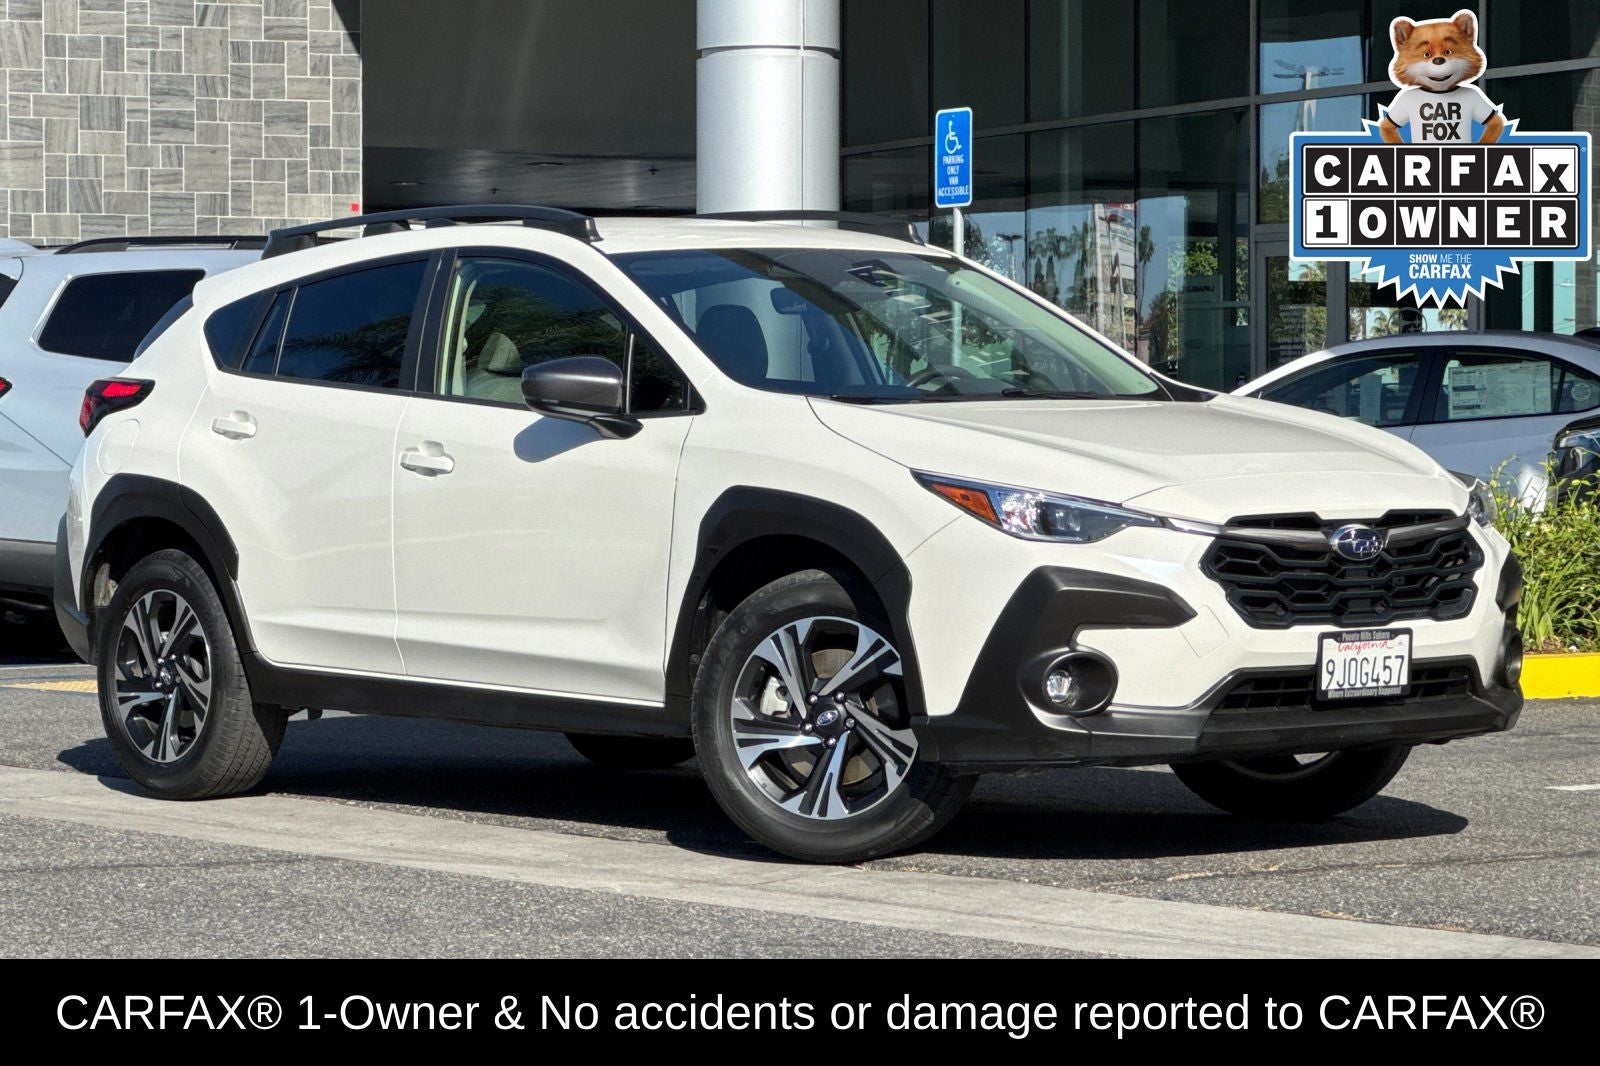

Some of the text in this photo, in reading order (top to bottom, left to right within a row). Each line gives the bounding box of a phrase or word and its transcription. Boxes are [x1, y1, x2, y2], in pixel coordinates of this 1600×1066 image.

[942, 154, 964, 165] PARKING
[946, 165, 959, 175] ONLY
[948, 176, 959, 185] VAN
[938, 185, 969, 196] ACCESSIBLE
[1373, 630, 1391, 640] Subaru
[1337, 640, 1395, 656] California
[1327, 690, 1344, 699] Where
[1344, 688, 1377, 698] Extraordinary
